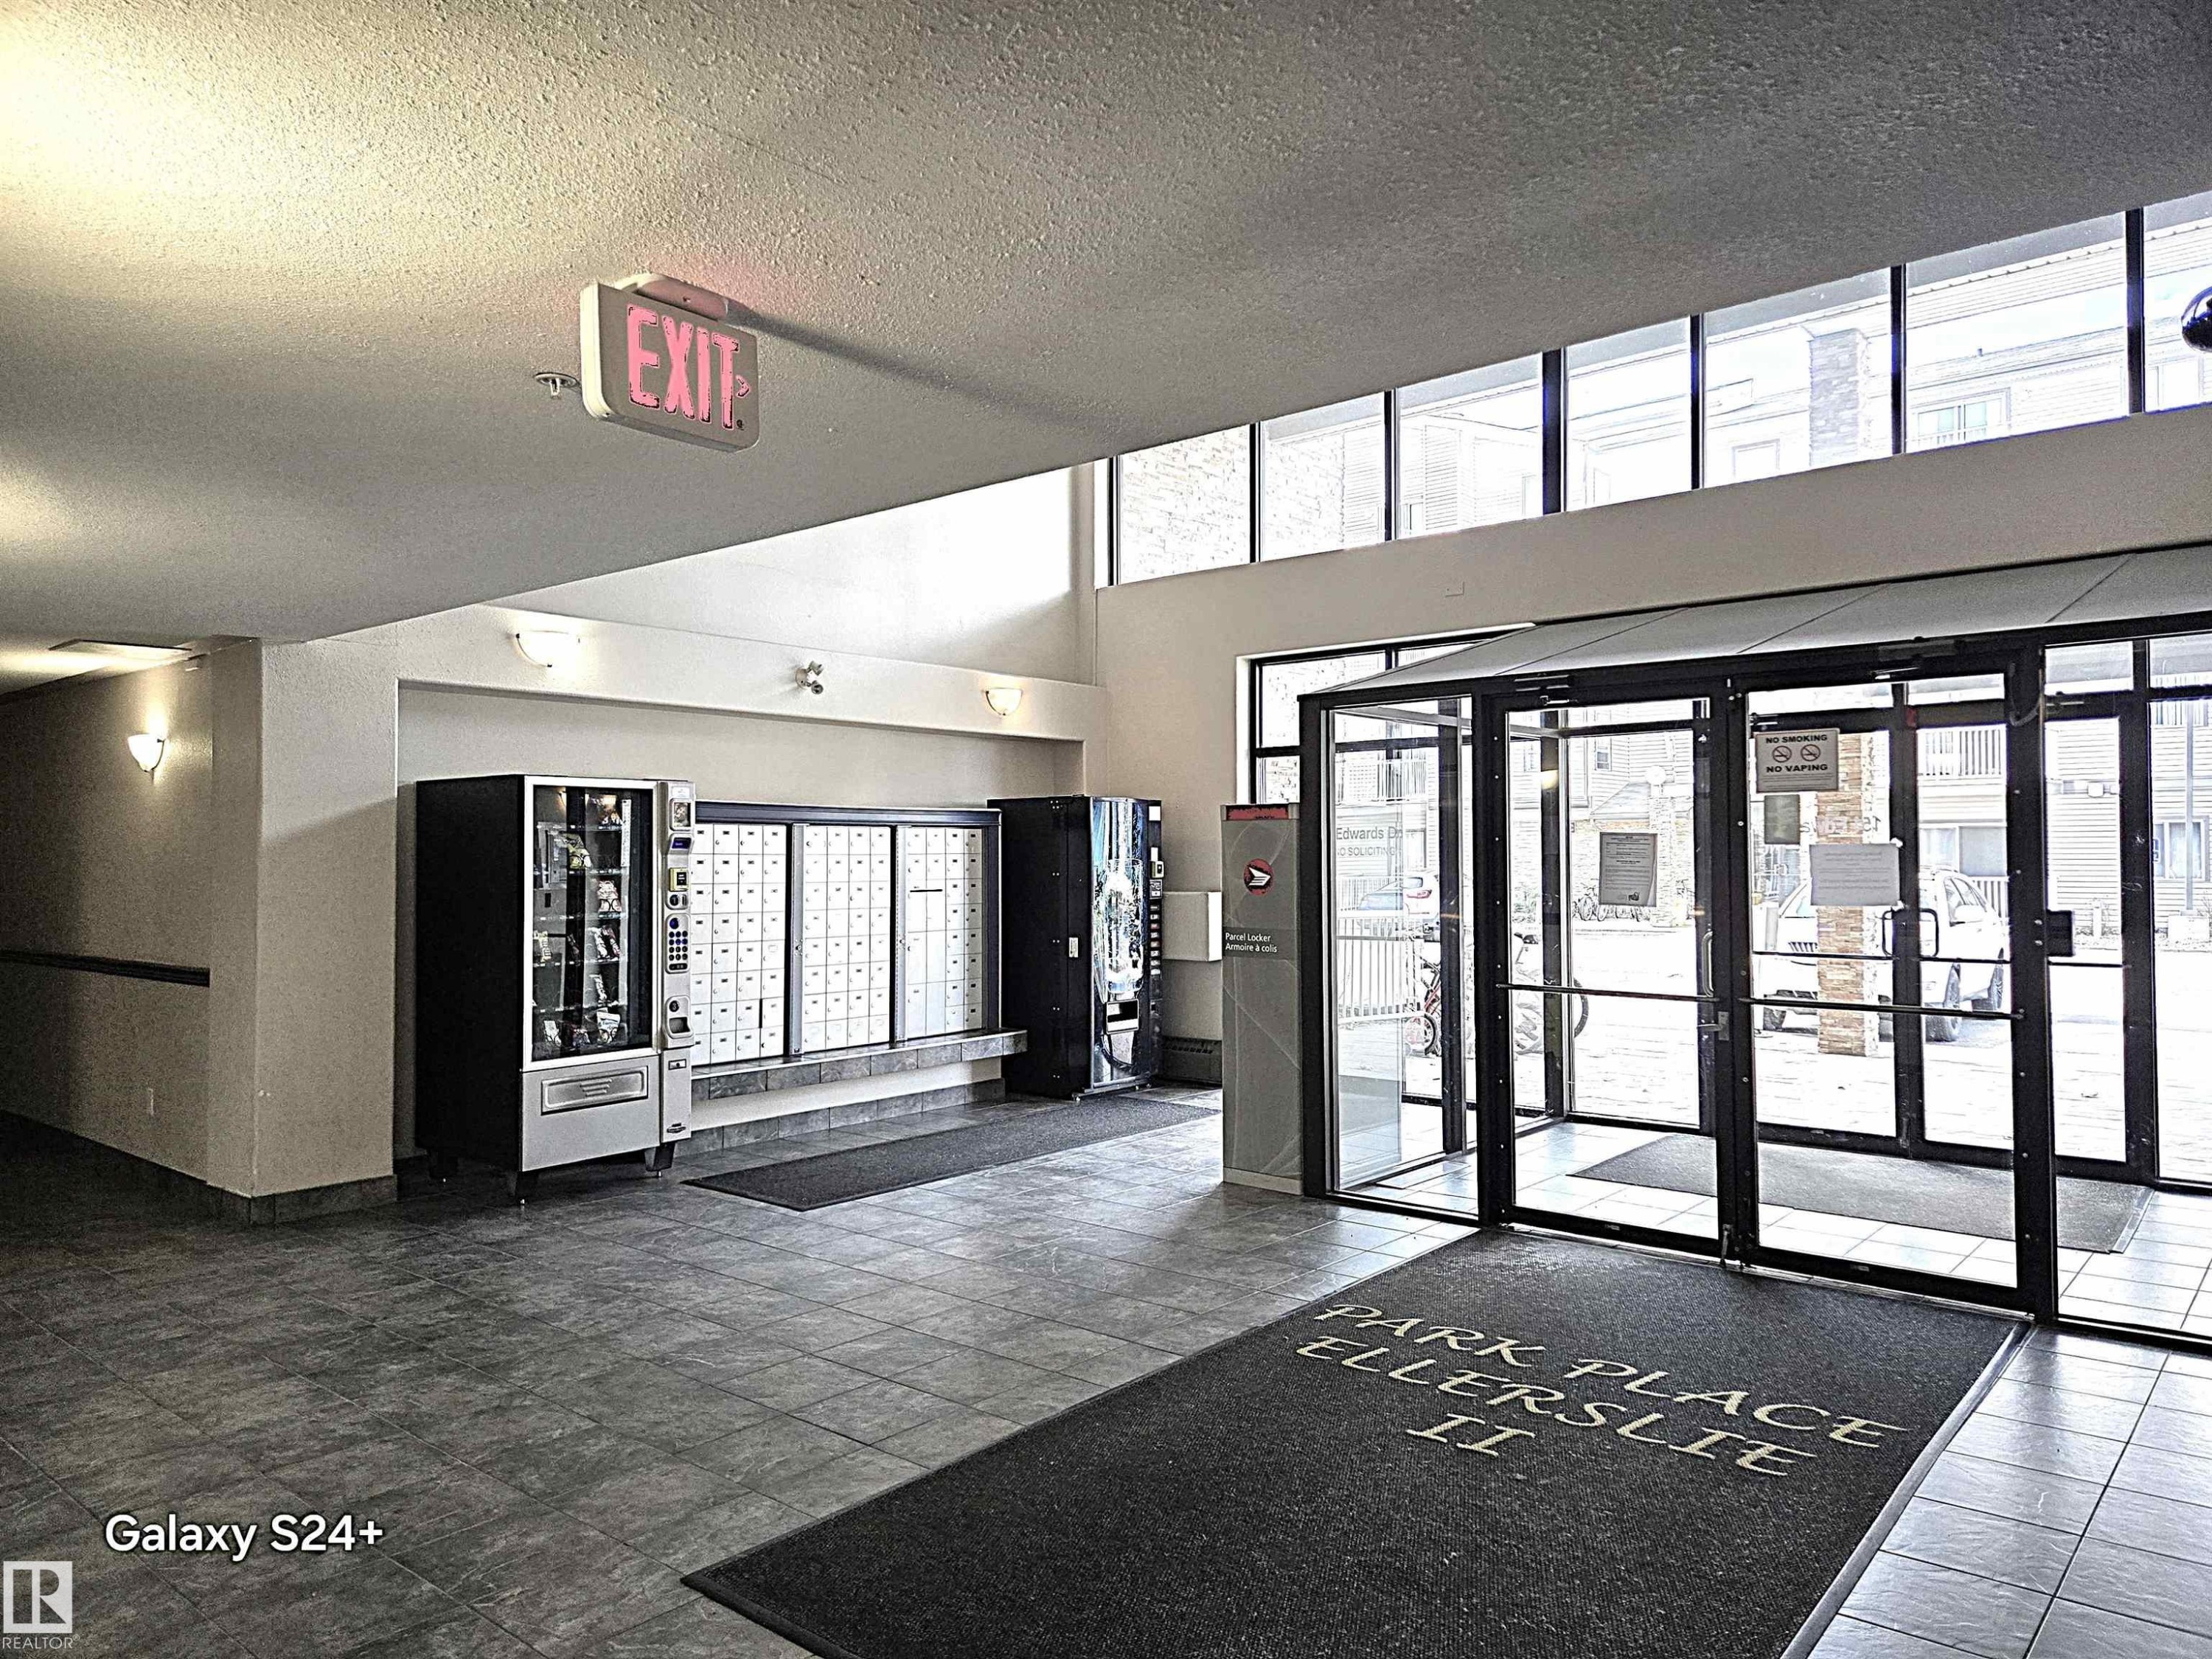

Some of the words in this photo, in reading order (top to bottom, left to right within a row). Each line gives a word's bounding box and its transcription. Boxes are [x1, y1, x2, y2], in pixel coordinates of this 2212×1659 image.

[627, 303, 740, 431] EXIT
[1781, 734, 1828, 743] SMOKING
[1785, 764, 1828, 772] VAPING
[1336, 827, 1384, 840] Edwards
[1348, 846, 1396, 856] SOLICITING
[1225, 933, 1246, 942] Parcel
[1248, 933, 1271, 942] Locker
[1225, 943, 1253, 951] Armoire
[1255, 943, 1260, 952] à
[1262, 944, 1277, 953] colis
[1315, 1303, 1546, 1368] PARK
[1564, 1358, 1913, 1449] PLACE
[1296, 1335, 1818, 1476] ELLERSLIE
[1406, 1413, 1536, 1457] II
